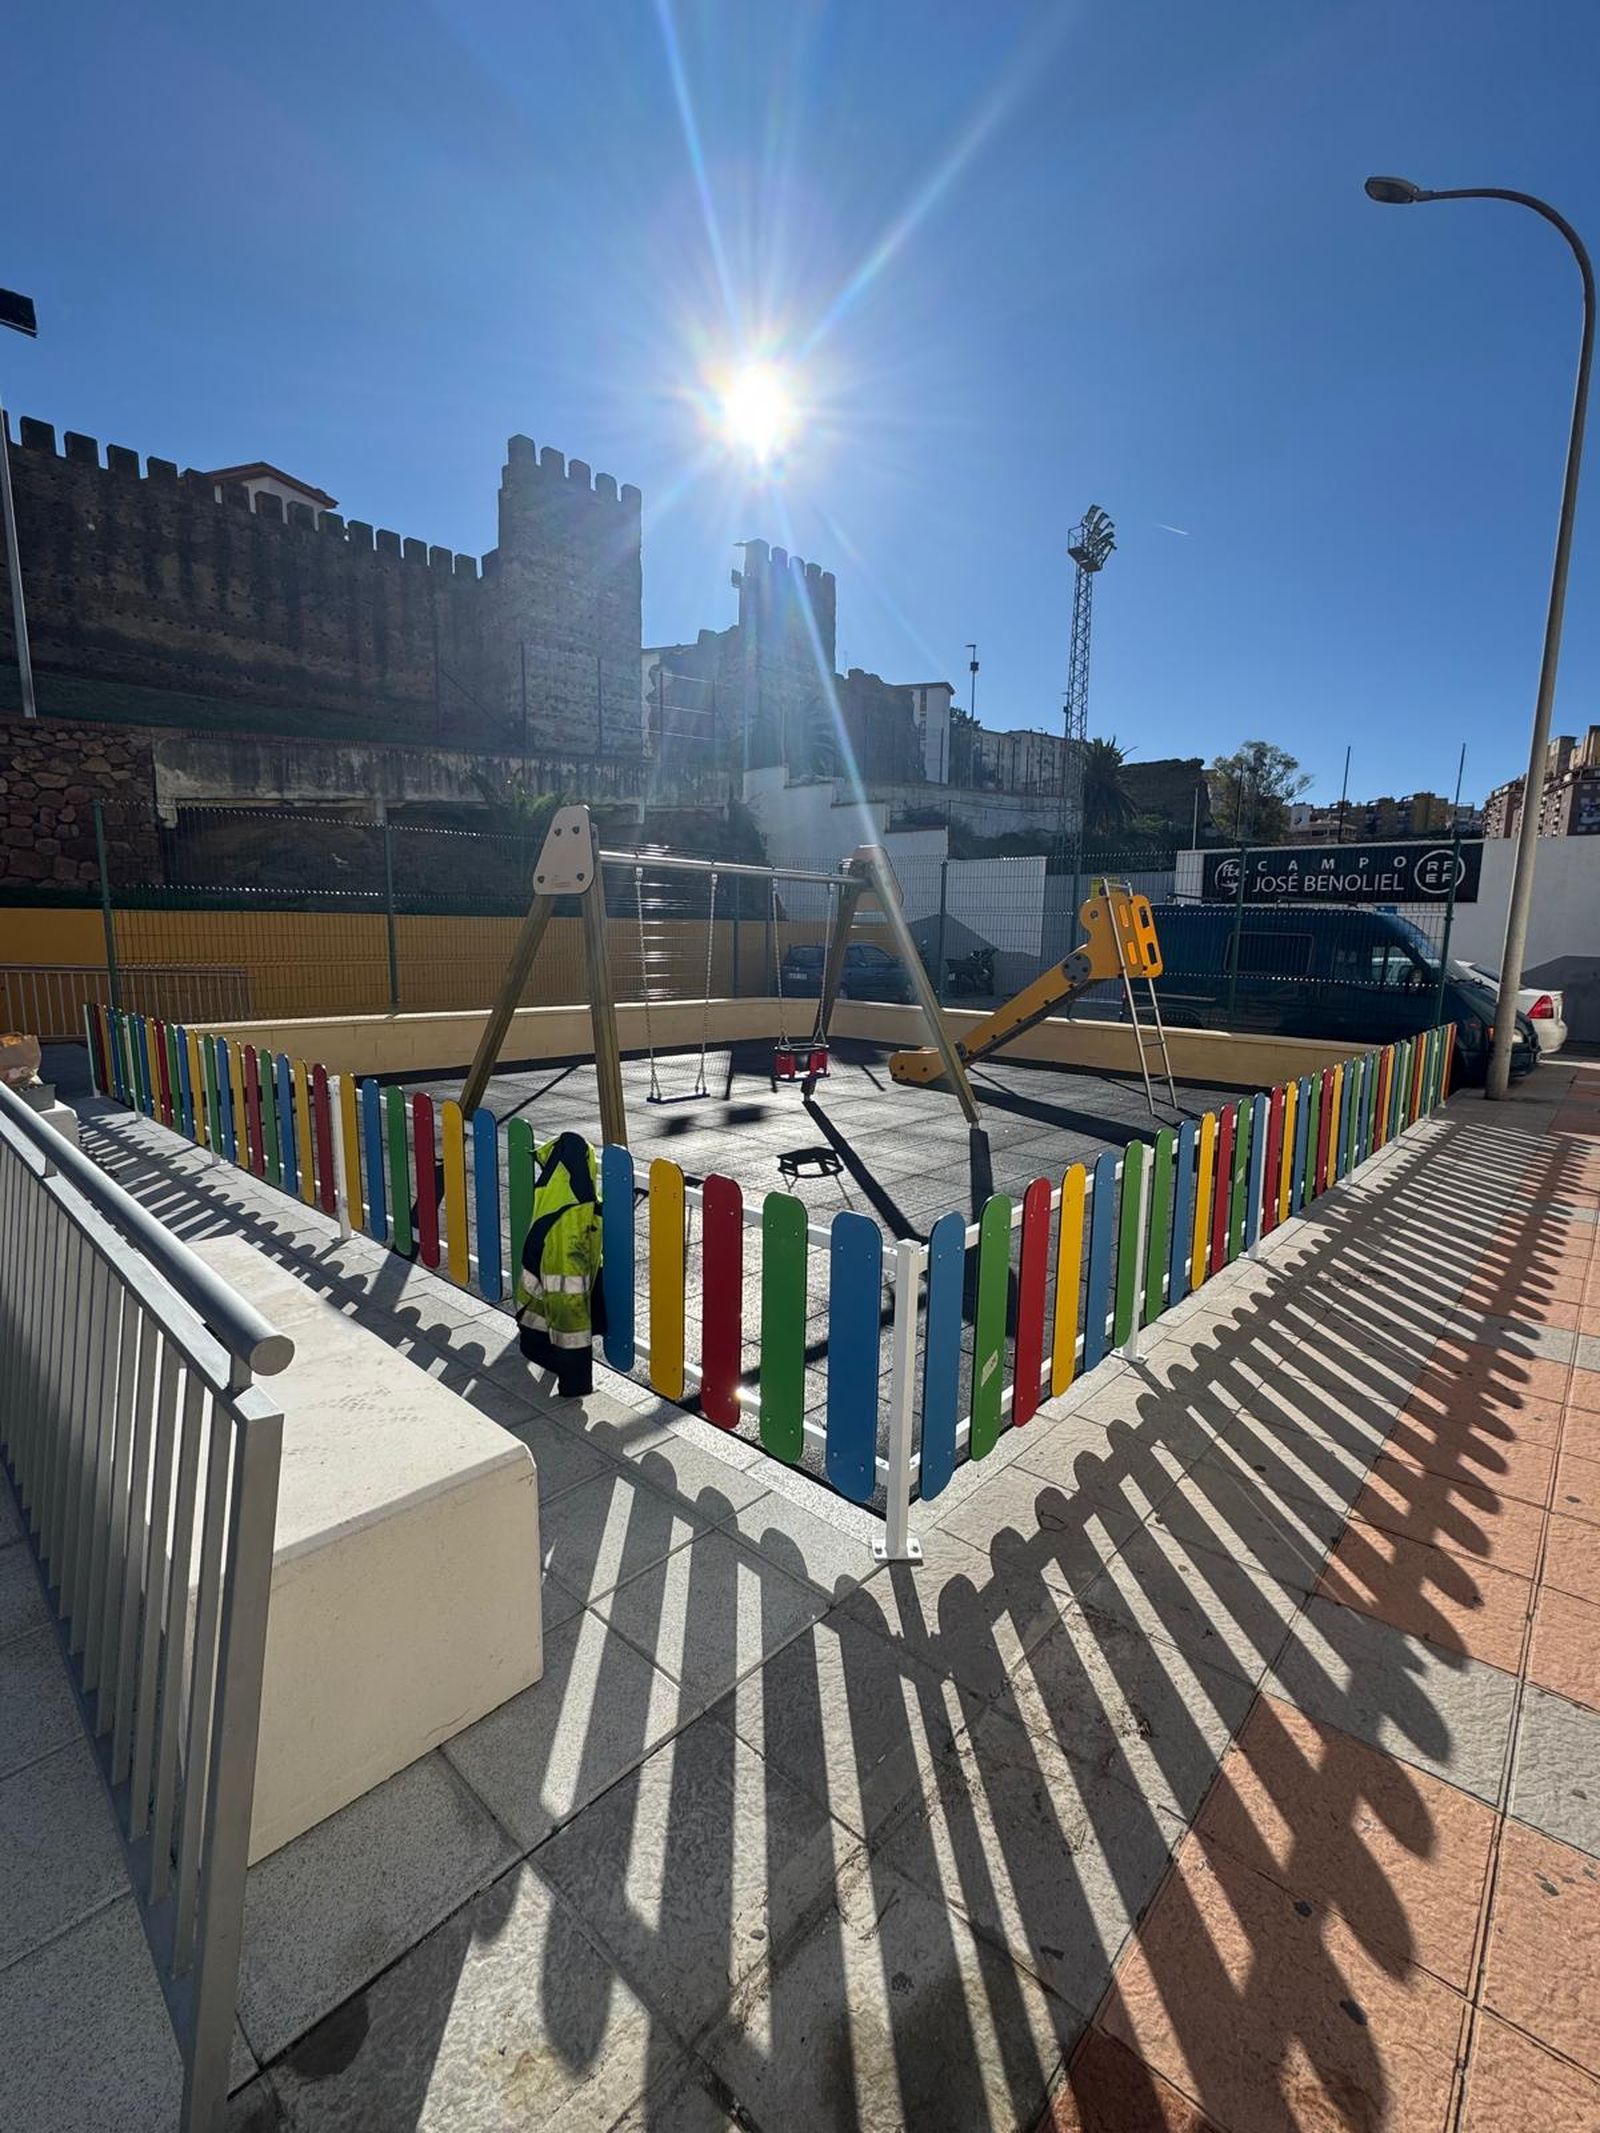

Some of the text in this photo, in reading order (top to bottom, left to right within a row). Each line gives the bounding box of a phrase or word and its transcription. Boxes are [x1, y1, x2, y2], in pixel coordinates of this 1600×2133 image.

[1257, 856, 1407, 872] CAMPO
[1427, 861, 1454, 871] RF
[1252, 873, 1405, 892] JOSÉ BENOLIEL
[1426, 873, 1452, 883] EF
